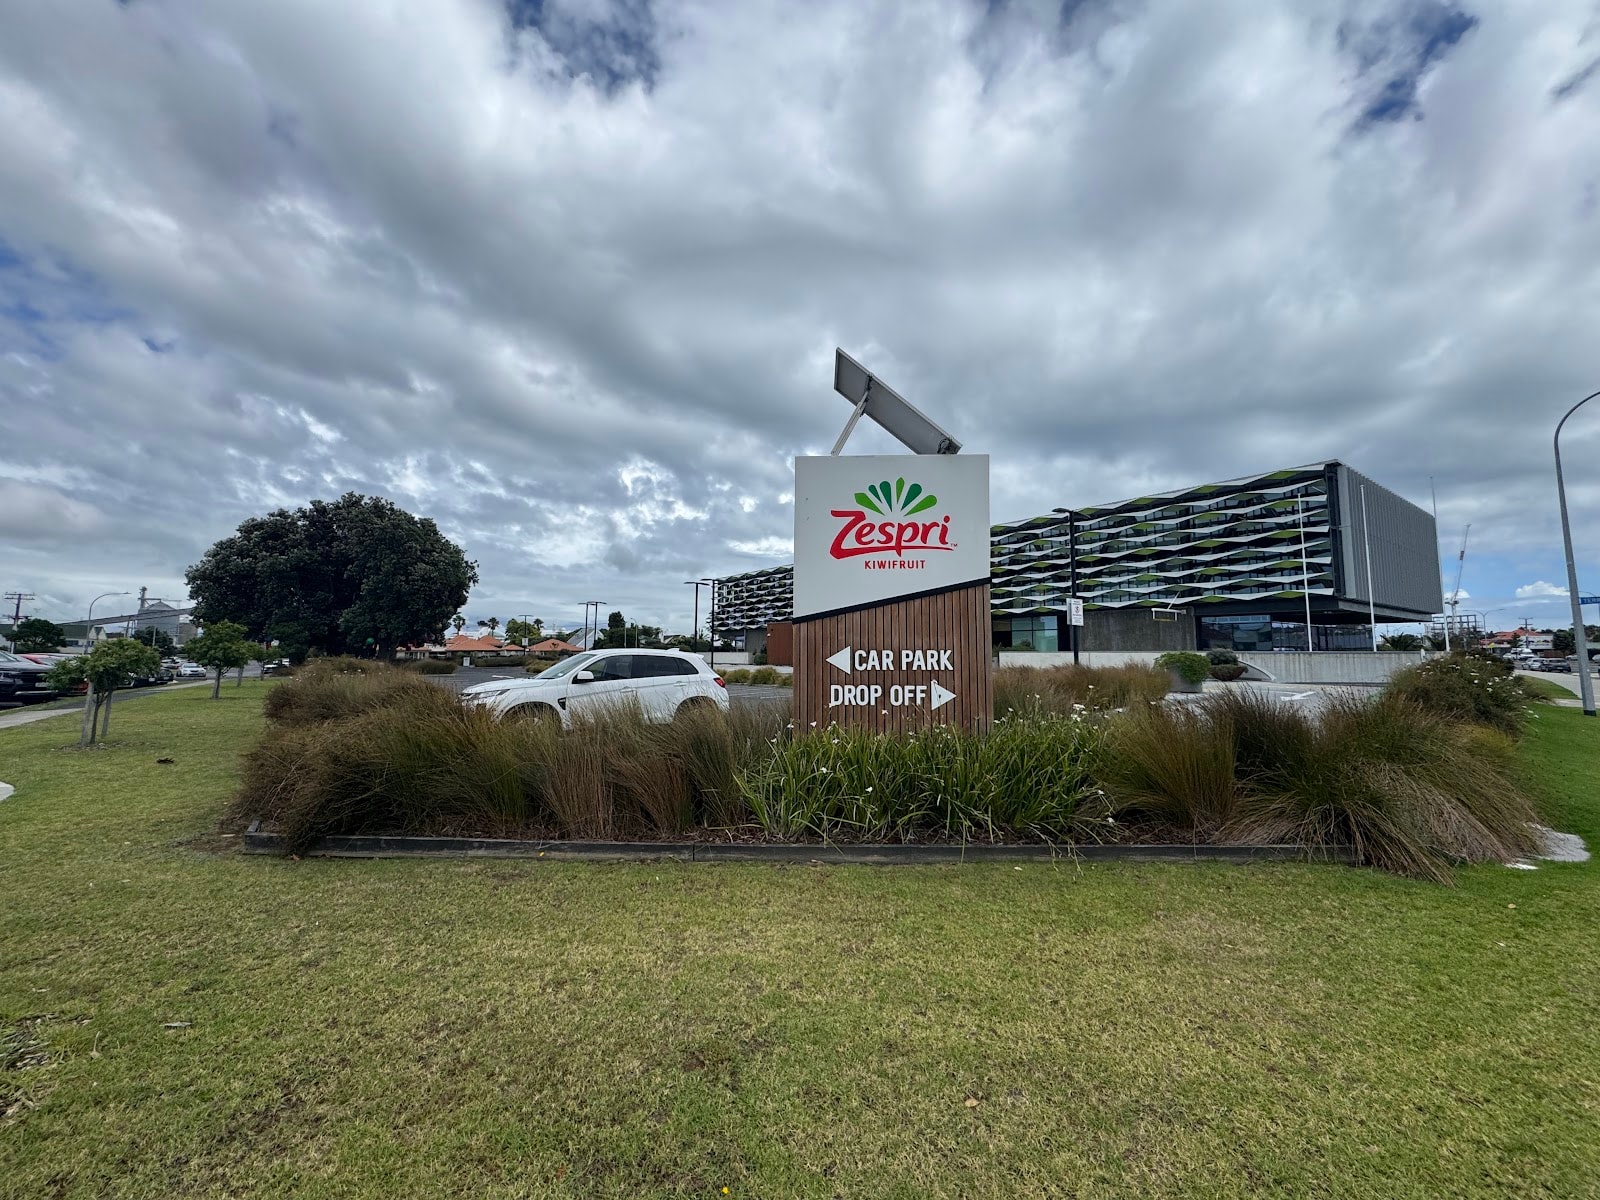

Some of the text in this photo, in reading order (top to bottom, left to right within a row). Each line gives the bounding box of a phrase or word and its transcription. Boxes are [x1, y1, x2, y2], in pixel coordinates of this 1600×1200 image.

[829, 510, 954, 560] Zespri
[864, 560, 926, 570] KIWIFRUIT
[854, 649, 954, 671] CAR PARK
[830, 684, 928, 706] DROP OFF
